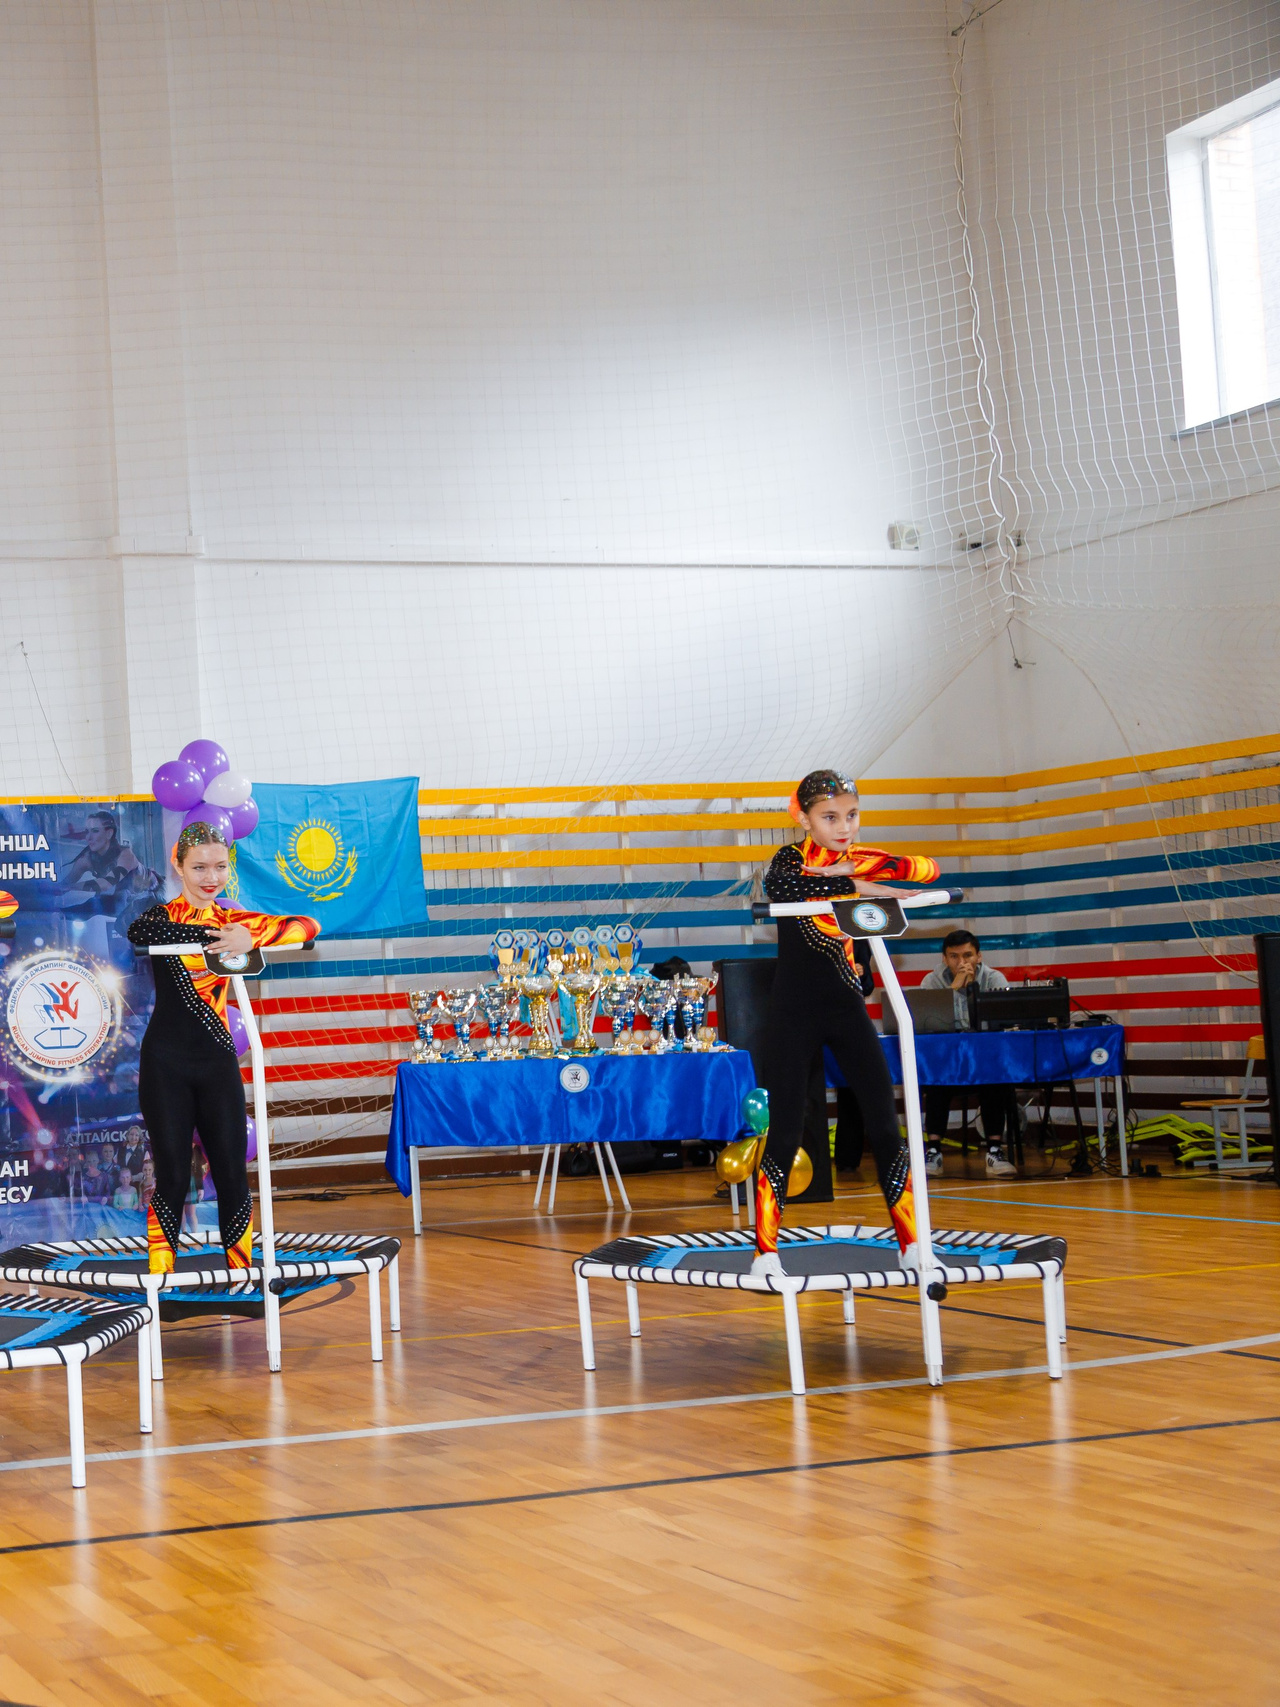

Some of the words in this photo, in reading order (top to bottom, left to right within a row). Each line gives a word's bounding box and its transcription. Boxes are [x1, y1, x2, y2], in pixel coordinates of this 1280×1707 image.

[9, 975, 29, 1014] ФЕДЕРАЦИЯ
[29, 963, 66, 978] ДЖАМПИНГ
[68, 964, 95, 984] ФИТНЕСА
[11, 1025, 29, 1052] RUSSIAN
[29, 1051, 56, 1066] JUMPING
[57, 1054, 84, 1066] FITNESS
[84, 1021, 108, 1057] FEDERATION
